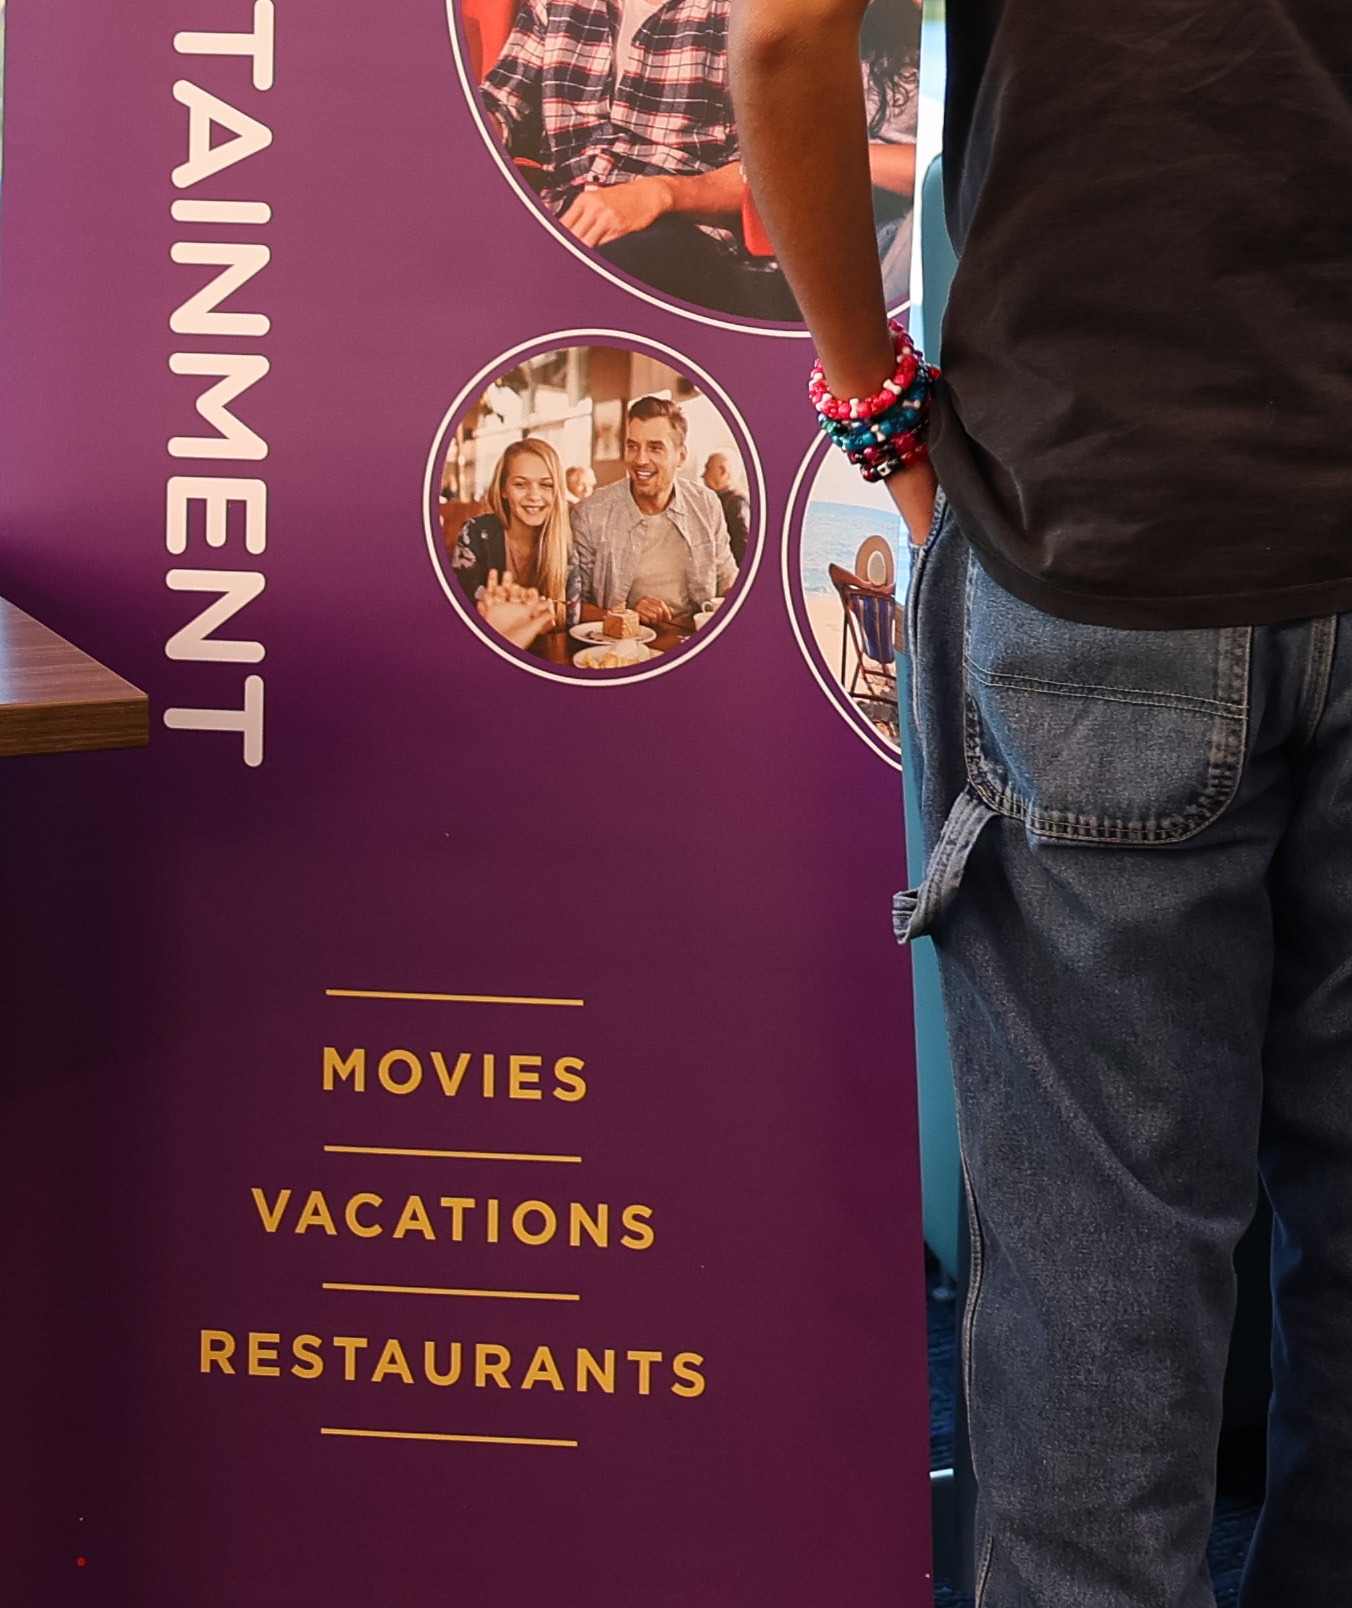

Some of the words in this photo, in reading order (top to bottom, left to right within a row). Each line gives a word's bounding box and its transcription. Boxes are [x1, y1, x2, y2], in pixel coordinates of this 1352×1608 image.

[323, 1047, 587, 1102] MOVIES
[251, 1188, 656, 1250] VACATIONS
[200, 1330, 706, 1397] RESTAURANTS
